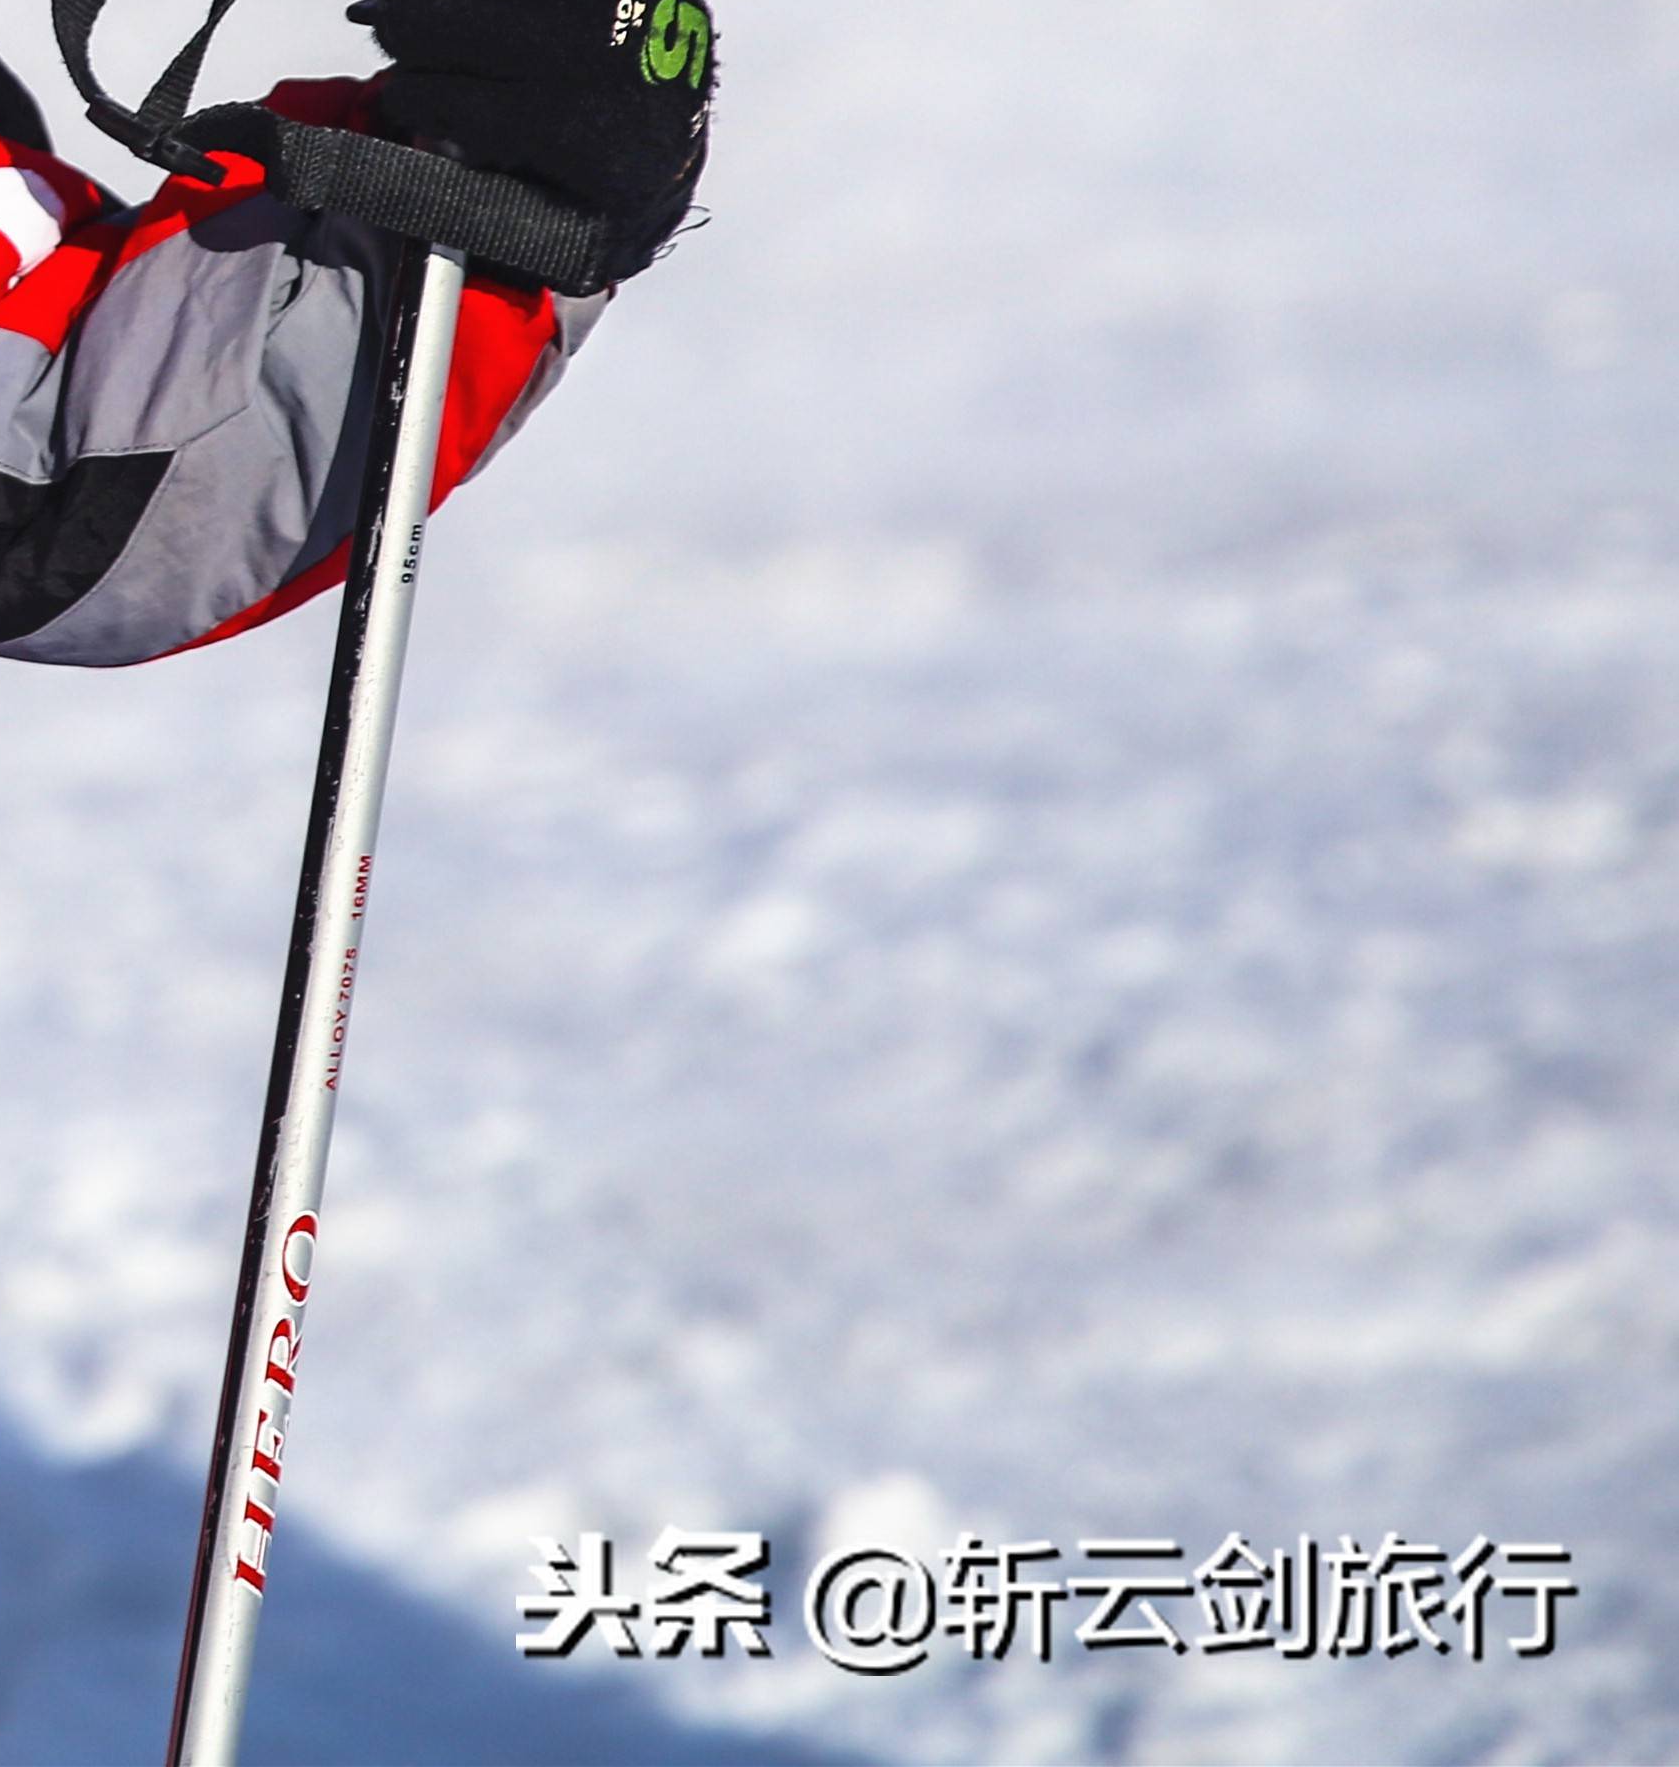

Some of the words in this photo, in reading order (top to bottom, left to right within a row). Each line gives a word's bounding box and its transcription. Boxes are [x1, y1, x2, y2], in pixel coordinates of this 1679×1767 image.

[401, 523, 423, 584] 95cm
[338, 947, 358, 1001] 7075
[351, 854, 372, 920] 16MM
[235, 1211, 319, 1597] HERO
